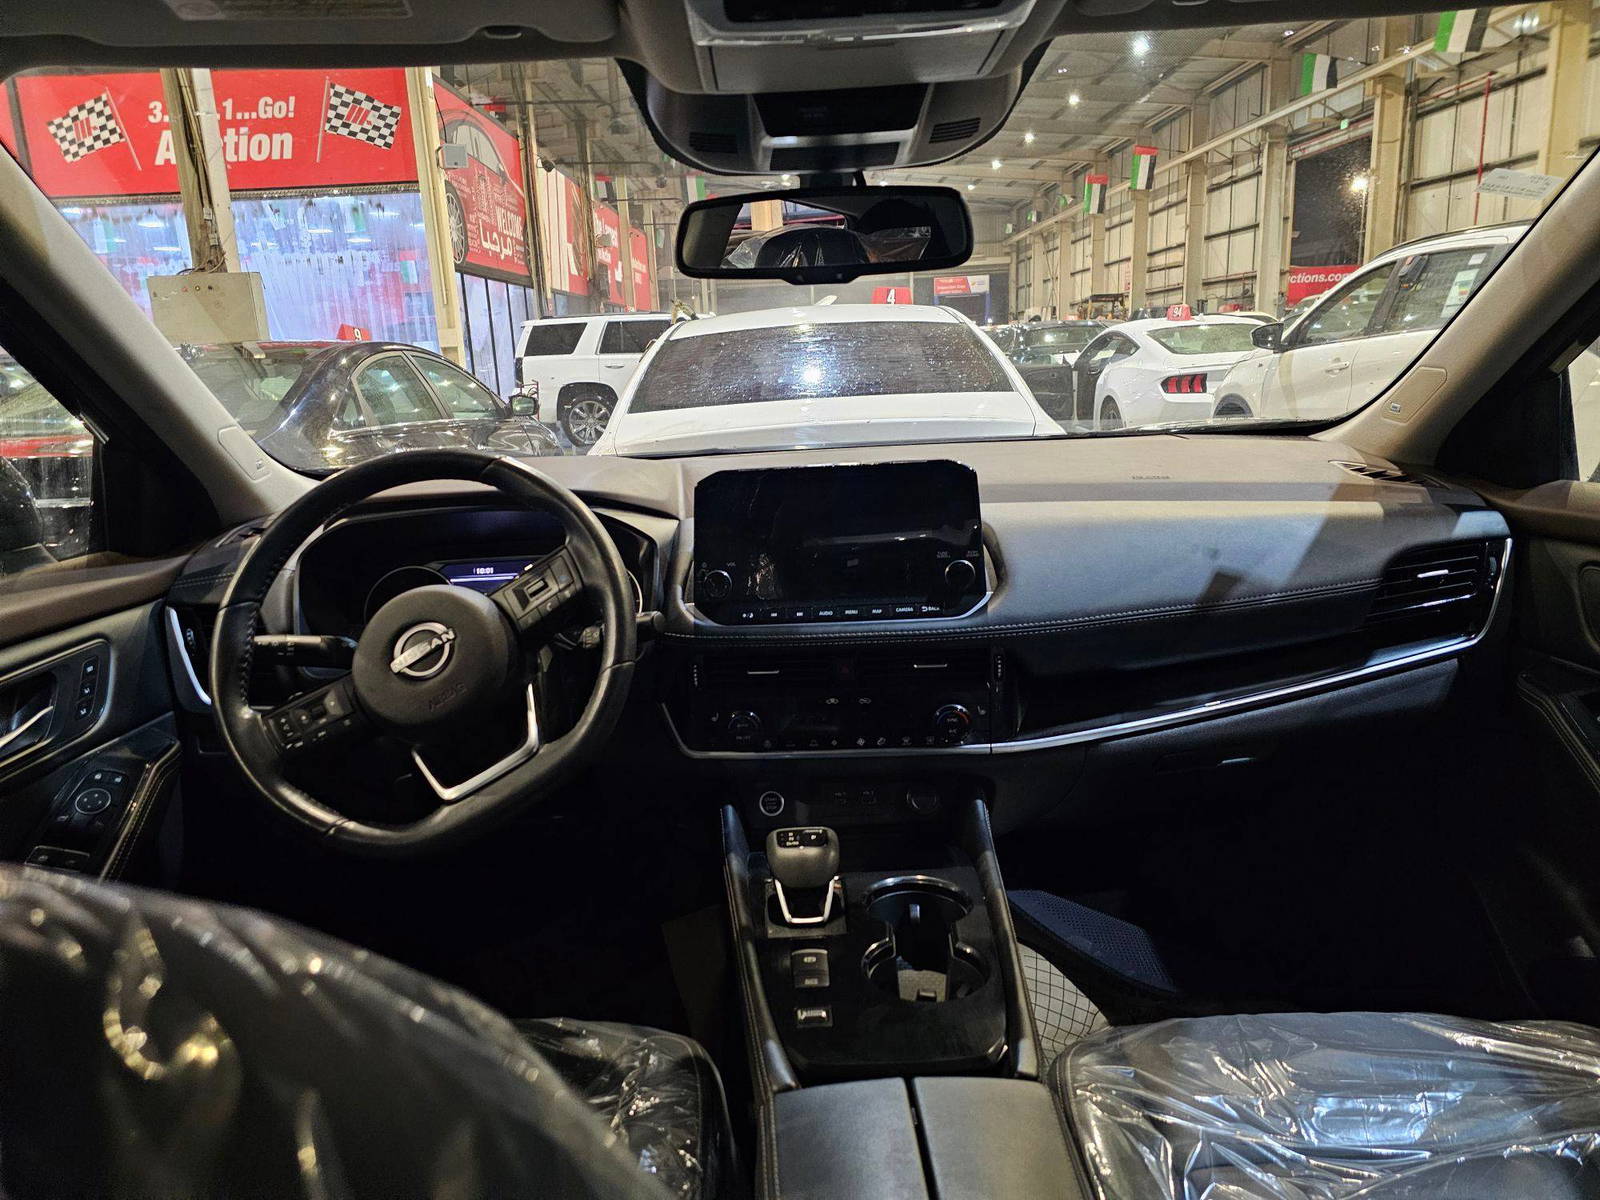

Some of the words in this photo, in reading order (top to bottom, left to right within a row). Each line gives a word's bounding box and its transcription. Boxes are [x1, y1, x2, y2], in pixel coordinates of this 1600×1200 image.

[154, 126, 293, 166] Ation
[495, 205, 524, 241] WELCOME
[479, 218, 513, 260] مرحبا
[1288, 272, 1351, 284] ctions.co
[886, 288, 896, 304] 4
[354, 327, 362, 341] 9
[476, 566, 494, 574] 10:01
